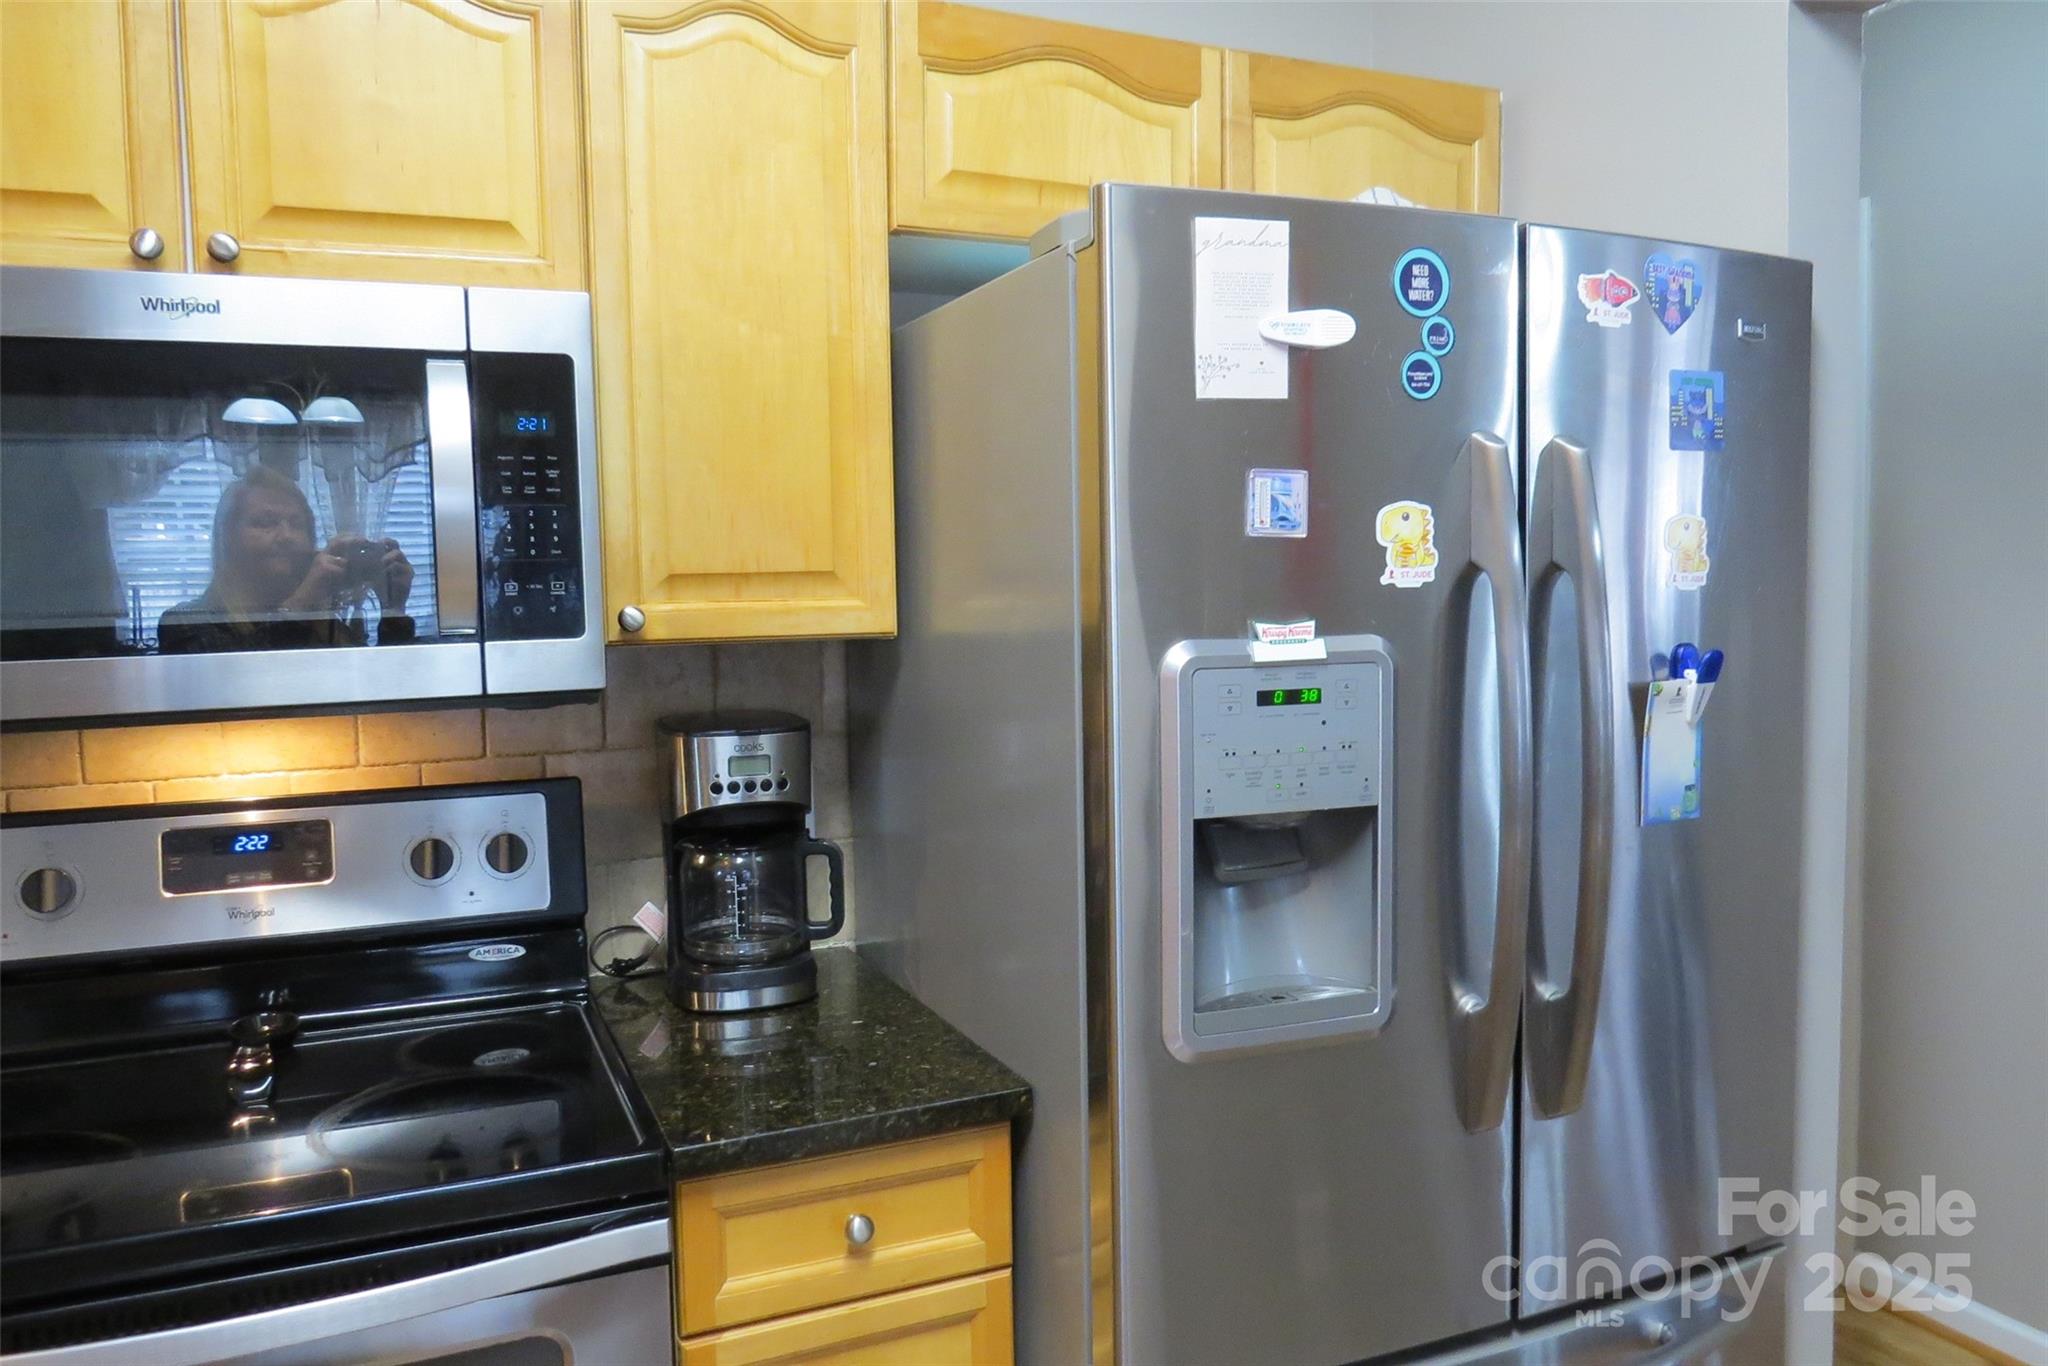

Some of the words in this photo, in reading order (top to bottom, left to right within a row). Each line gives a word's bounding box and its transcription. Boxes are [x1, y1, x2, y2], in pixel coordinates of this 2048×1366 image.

[1196, 223, 1288, 256] grandma
[1412, 264, 1429, 276] NEED
[1411, 277, 1430, 289] MORE
[1407, 289, 1434, 301] WATER?
[140, 296, 221, 317] Whirlpool
[517, 417, 546, 431] 2:21
[1262, 626, 1287, 638] Krispy
[1288, 625, 1312, 637] Kreme
[1300, 689, 1319, 703] 38
[733, 742, 765, 753] cooks
[234, 835, 269, 851] 2:22
[227, 907, 275, 921] Whirlpool
[475, 946, 521, 957] AMERICA
